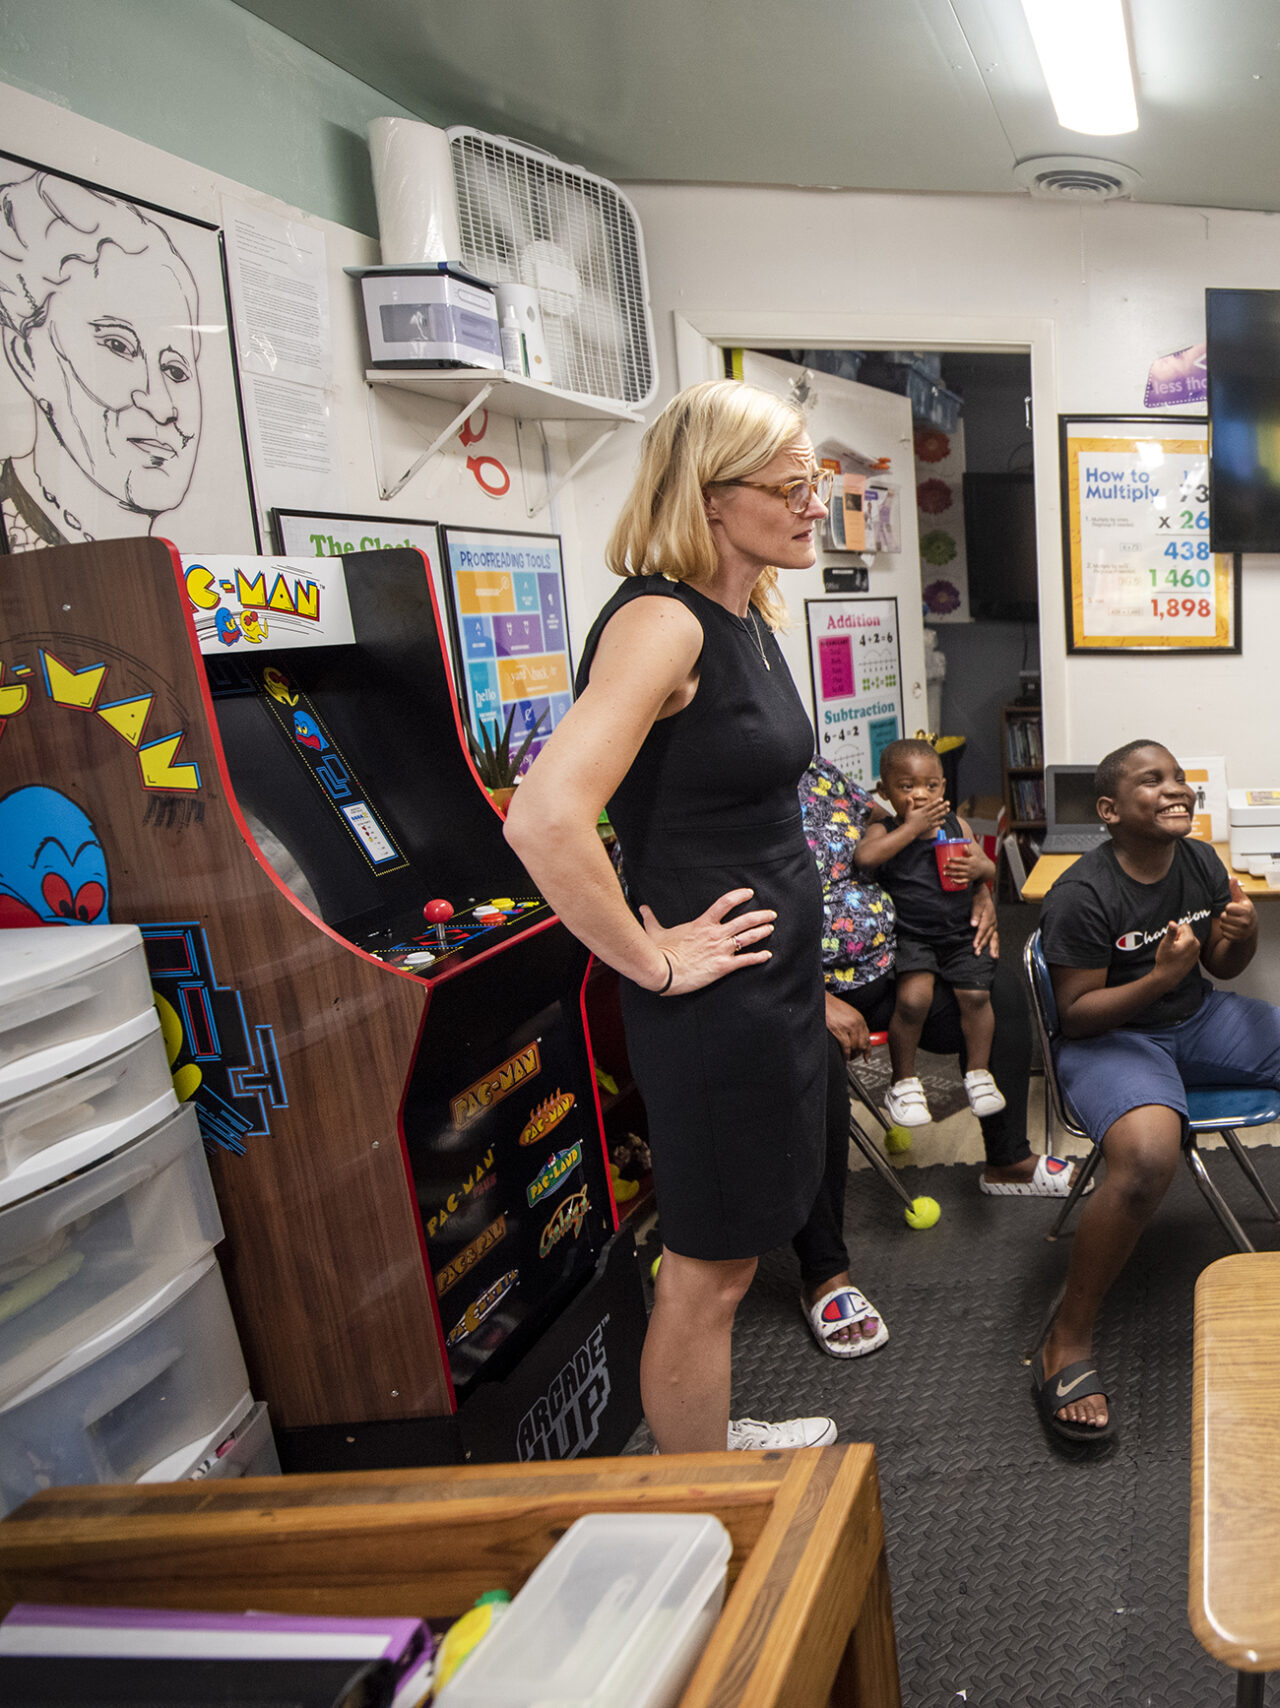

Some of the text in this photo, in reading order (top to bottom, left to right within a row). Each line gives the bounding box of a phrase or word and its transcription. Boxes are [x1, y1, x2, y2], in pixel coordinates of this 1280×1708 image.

[1154, 376, 1208, 395] less tha
[1086, 467, 1150, 483] How to
[1086, 484, 1160, 504] Multiply
[1180, 510, 1211, 530] 26
[309, 534, 355, 558] The
[1164, 541, 1211, 561] 438
[460, 550, 552, 569] PROOFREADING TOOLS
[184, 562, 321, 623] C-MAN
[1151, 598, 1212, 621] 1,898
[827, 614, 880, 630] Addition
[824, 701, 895, 725] Subtraction
[455, 1049, 538, 1126] PAC-MAN
[524, 1096, 571, 1144] PAC-MAN
[530, 1149, 578, 1200] PAC-LAND
[427, 1149, 494, 1237] PAC-MAN
[539, 1183, 591, 1259] Galaga
[516, 1323, 607, 1463] ARCADE
